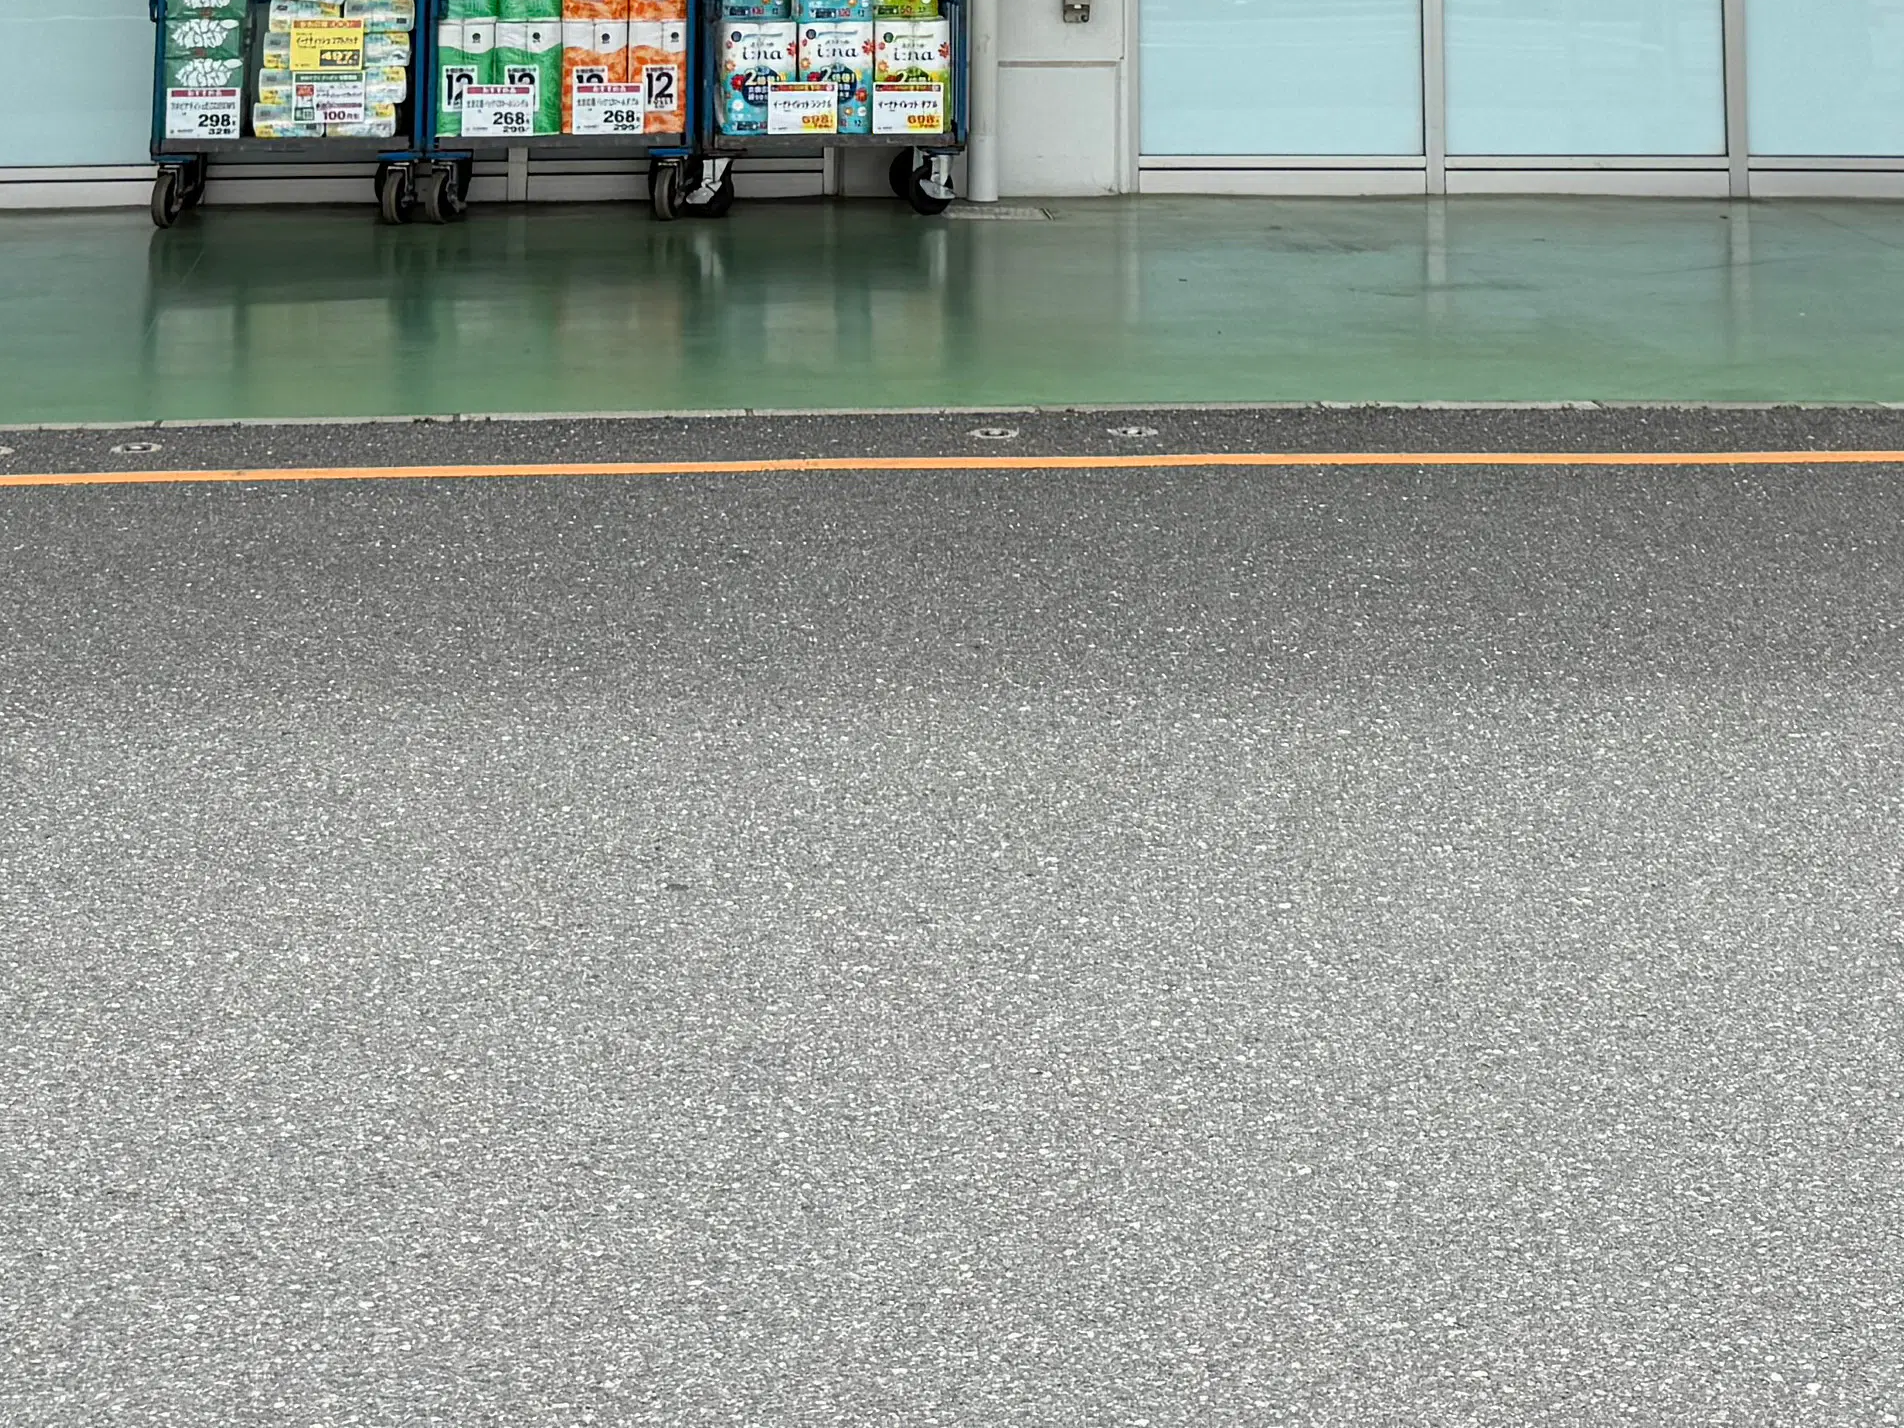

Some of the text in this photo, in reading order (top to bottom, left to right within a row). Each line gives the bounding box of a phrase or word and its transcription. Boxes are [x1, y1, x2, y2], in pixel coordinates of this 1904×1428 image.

[647, 72, 674, 99] 12
[198, 113, 231, 127] 298
[493, 111, 525, 125] 268
[603, 110, 635, 123] 268
